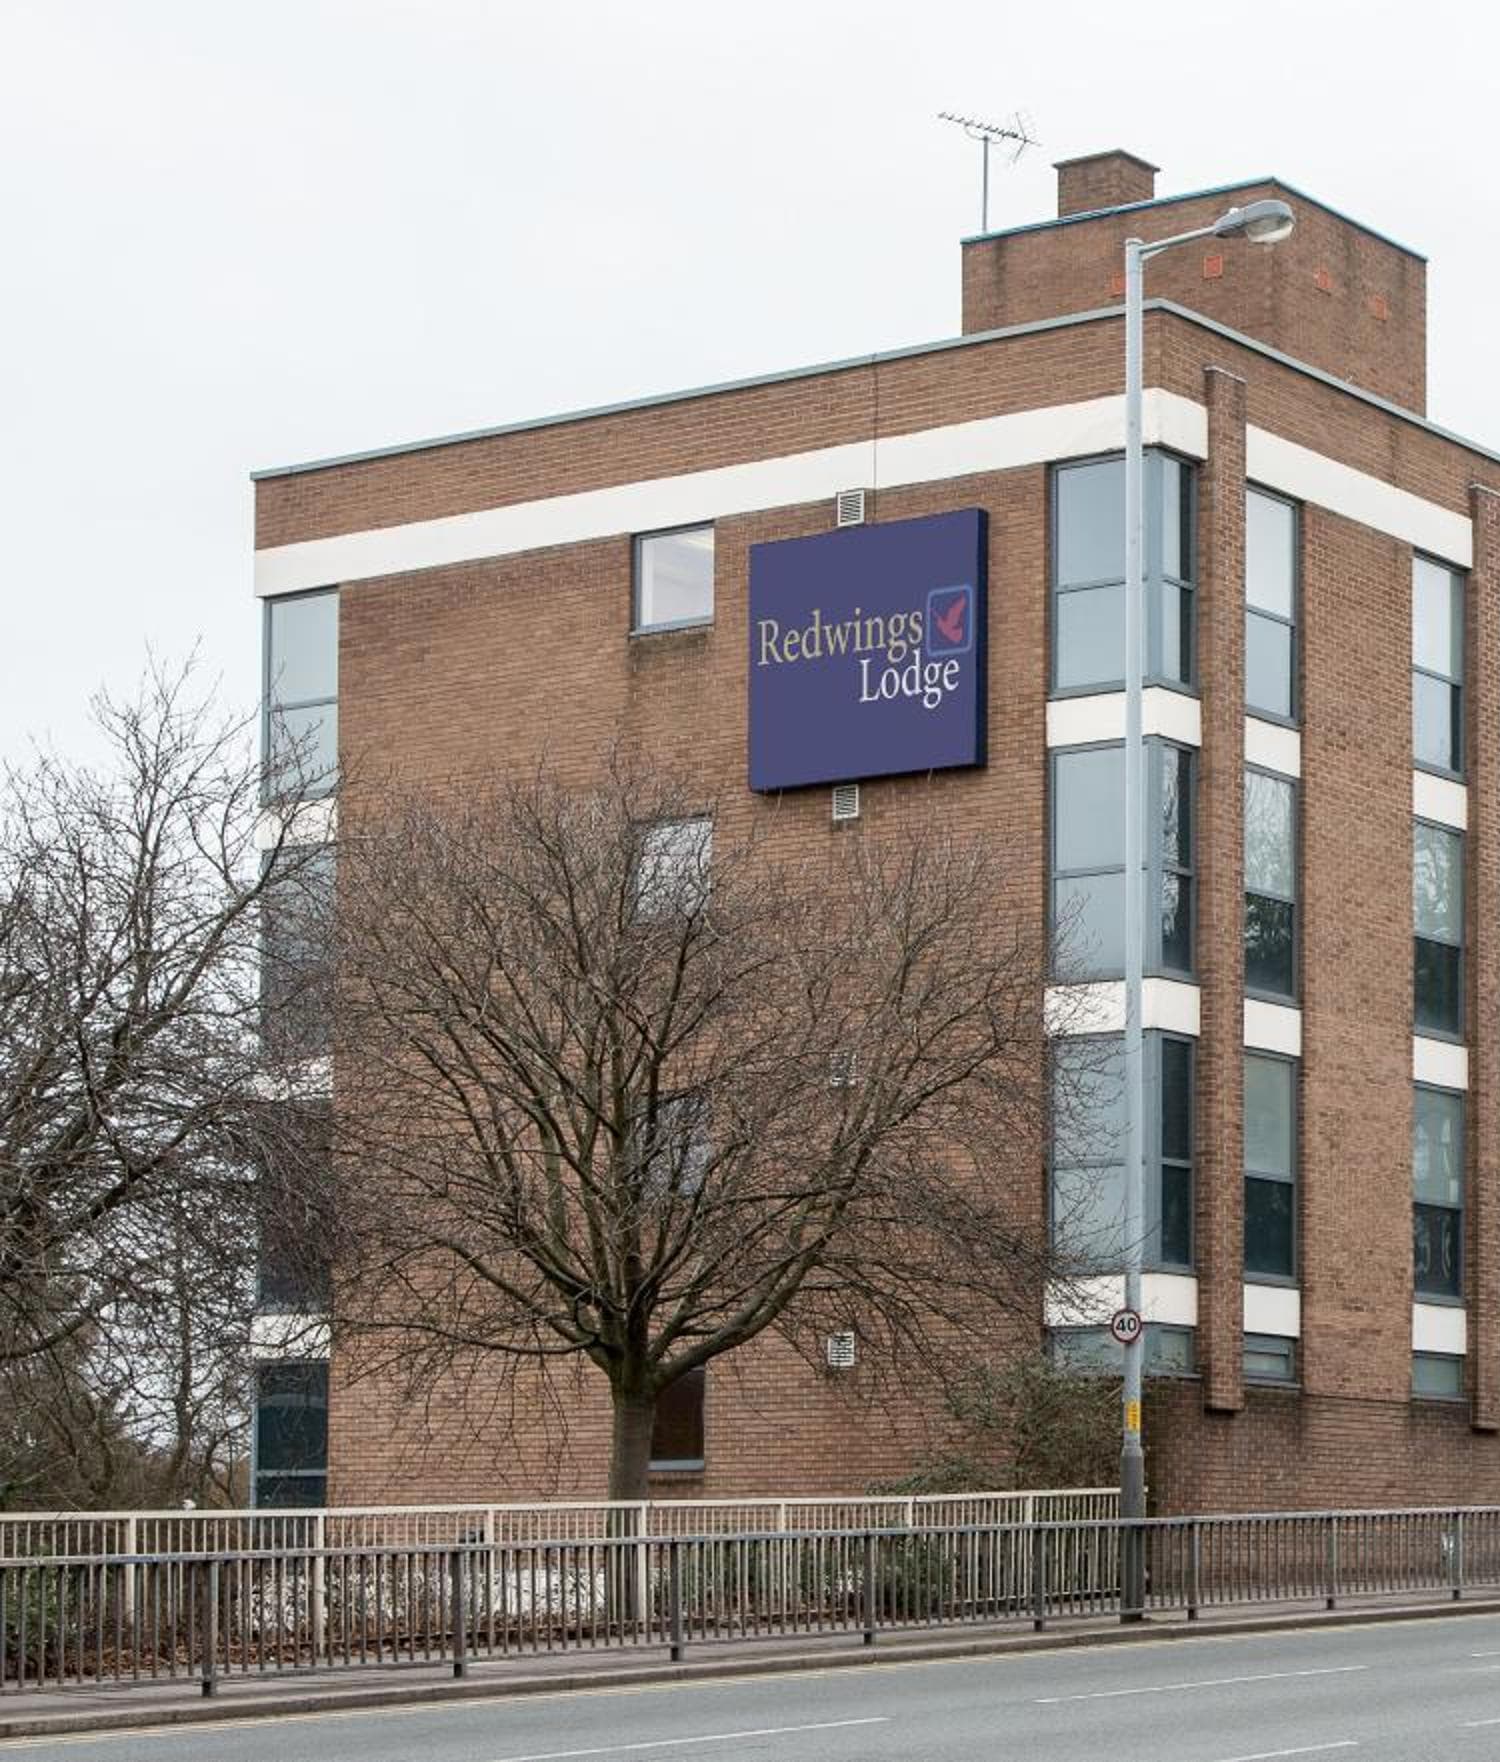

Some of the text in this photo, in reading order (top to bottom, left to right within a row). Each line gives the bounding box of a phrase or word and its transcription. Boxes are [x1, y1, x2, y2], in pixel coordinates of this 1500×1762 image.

[757, 608, 924, 665] Redwings
[859, 647, 960, 709] Lodge
[1115, 1317, 1137, 1333] 40
